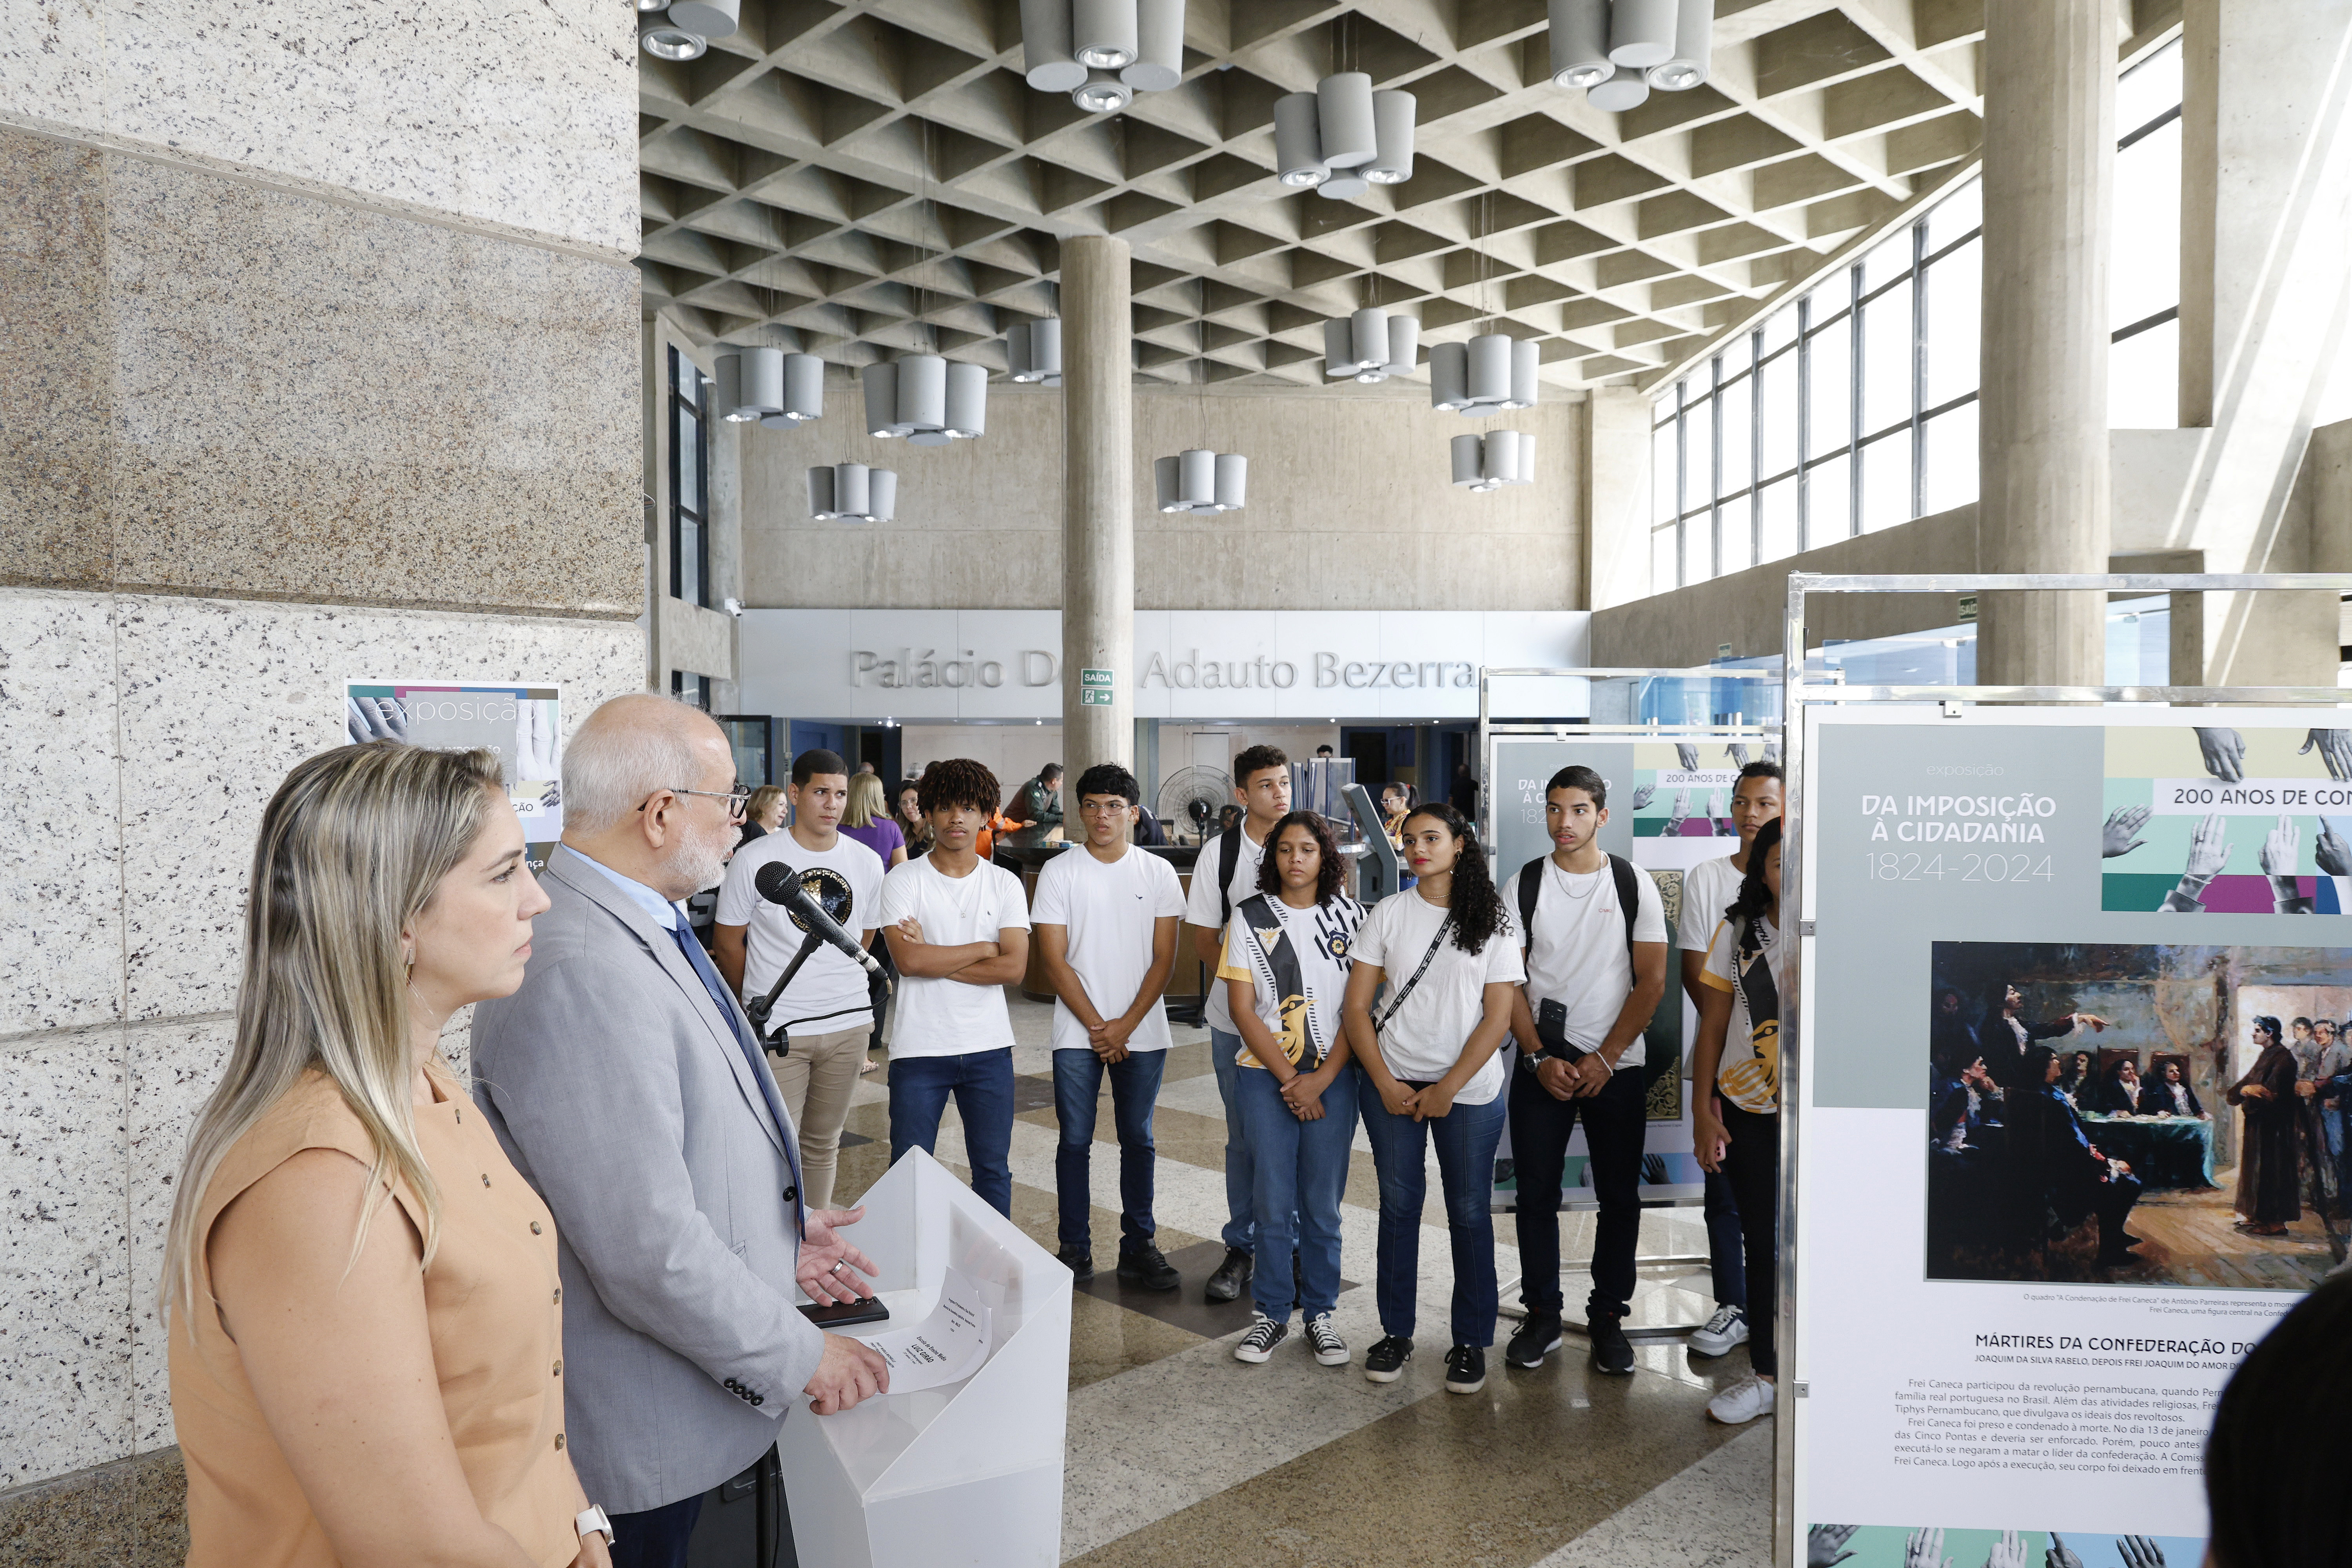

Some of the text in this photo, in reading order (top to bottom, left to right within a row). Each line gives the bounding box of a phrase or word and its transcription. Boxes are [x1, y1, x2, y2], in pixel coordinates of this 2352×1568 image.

[851, 648, 1480, 689] Palácio D Adauto Bezerra
[1084, 671, 1111, 683] SAÍDA
[375, 697, 536, 724] exposição
[1666, 774, 1684, 783] 200
[1687, 774, 1713, 783] ANOS
[1716, 775, 1728, 783] DE
[1926, 762, 2004, 778] exposição
[1518, 779, 1537, 790] DA
[1523, 790, 1532, 804] À
[2174, 788, 2213, 804] 200
[2220, 789, 2275, 805] ANOS
[2282, 790, 2308, 805] DE
[1861, 792, 2056, 822] DA IMPOSIÇÃO
[1871, 817, 2045, 844] À CIDADANIA
[1866, 852, 2056, 882] 1824-2024
[2207, 1308, 2227, 1316] figura
[916, 1336, 927, 1345] Escola
[929, 1346, 939, 1356] Ensino
[937, 1352, 947, 1362] Médio
[1975, 1332, 2054, 1349] MÁRTIRES
[2060, 1337, 2082, 1349] DA
[2089, 1338, 2225, 1356] CONFEDERAÇÃO
[911, 1344, 923, 1353] LUIZ
[920, 1352, 934, 1363] GIRÃO
[1975, 1355, 2014, 1363] JOAQUIM
[2055, 1357, 2089, 1366] RABELO,
[2144, 1360, 2184, 1368] JOAQUIM
[1909, 1379, 1925, 1387] Frei
[1929, 1379, 1963, 1388] Caneca
[1967, 1381, 2014, 1392] participou
[2018, 1382, 2030, 1390] da
[2034, 1383, 2080, 1394] revolução
[2084, 1385, 2158, 1396] pernambucana,
[2161, 1388, 2199, 1397] quando
[1895, 1391, 1926, 1401] família
[1929, 1393, 1946, 1401] real
[1950, 1394, 2004, 1404] portuguesa
[2023, 1395, 2050, 1404] Brasil.
[2053, 1396, 2078, 1405] Além
[2081, 1397, 2098, 1406] das
[2100, 1398, 2149, 1408] atividades
[2152, 1400, 2199, 1410] religiosas,
[2203, 1400, 2220, 1411] Frei
[1895, 1405, 1925, 1415] Tiphys
[1927, 1405, 2000, 1417] Pernambucano,
[2003, 1410, 2021, 1418] que
[2023, 1408, 2069, 1419] divulgava
[2085, 1410, 2112, 1419] ideais
[2114, 1412, 2131, 1420] dos
[2134, 1412, 2185, 1422] revoltosos.
[1908, 1418, 1925, 1426] Frei
[1927, 1418, 1961, 1428] Caneca
[1964, 1419, 1976, 1428] foi
[1978, 1422, 2005, 1430] preso
[2015, 1422, 2069, 1431] condenado
[2071, 1423, 2077, 1432] à
[2114, 1425, 2127, 1433] No
[2130, 1425, 2144, 1434] dia
[2161, 1426, 2174, 1435] de
[2175, 1427, 2210, 1438] janeiro
[1895, 1430, 1911, 1439] das
[1915, 1431, 1941, 1440] Cinco
[1945, 1432, 1977, 1441] Pontas
[1991, 1434, 2025, 1443] deveria
[2048, 1435, 2098, 1445] enforcado.
[2103, 1437, 2135, 1447] Porém,
[1895, 1445, 1943, 1453] executá-lo
[1959, 1447, 2000, 1456] negaram
[2076, 1449, 2088, 1458] da
[2091, 1450, 2158, 1462] confederação.
[2161, 1452, 2168, 1461] A
[1895, 1456, 1911, 1465] Frei
[1913, 1457, 1950, 1466] Caneca.
[1952, 1458, 1976, 1469] Logo
[1978, 1461, 2000, 1469] após
[2010, 1461, 2056, 1471] execução,
[2078, 1465, 2105, 1473] corpo
[2108, 1463, 2120, 1472] foi
[2122, 1464, 2160, 1474] deixado
